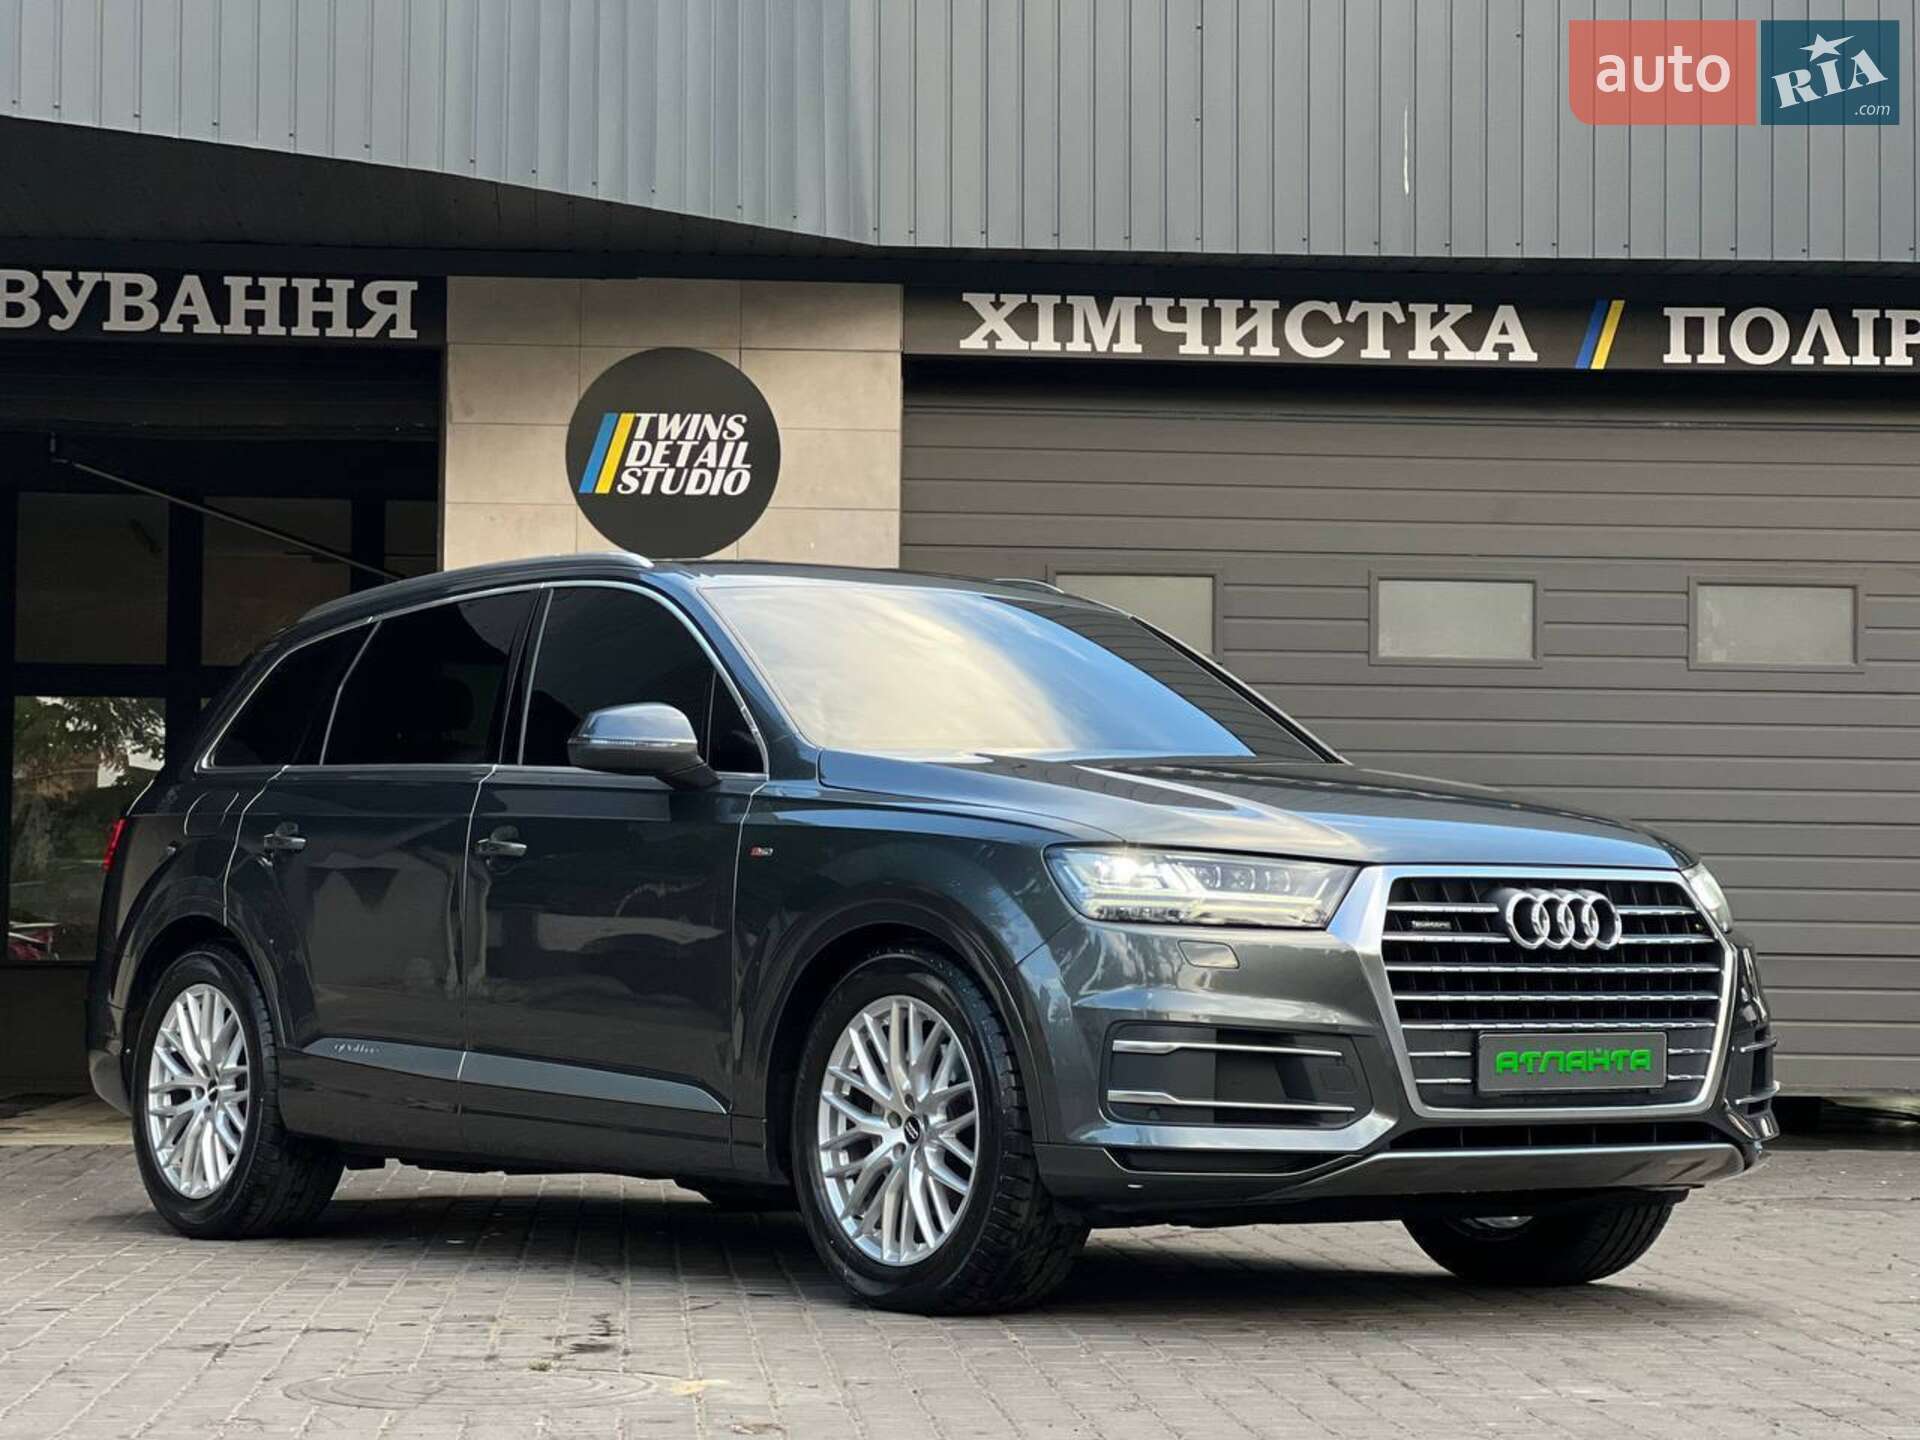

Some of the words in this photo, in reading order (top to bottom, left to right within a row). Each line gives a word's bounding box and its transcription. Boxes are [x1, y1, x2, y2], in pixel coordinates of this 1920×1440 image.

[0, 269, 418, 339] ВУВАННЯ
[959, 292, 1539, 362] ХІМЧИСТКА
[634, 412, 748, 441] TWINS
[625, 440, 752, 469] DETAIL
[616, 467, 752, 496] STUDIO
